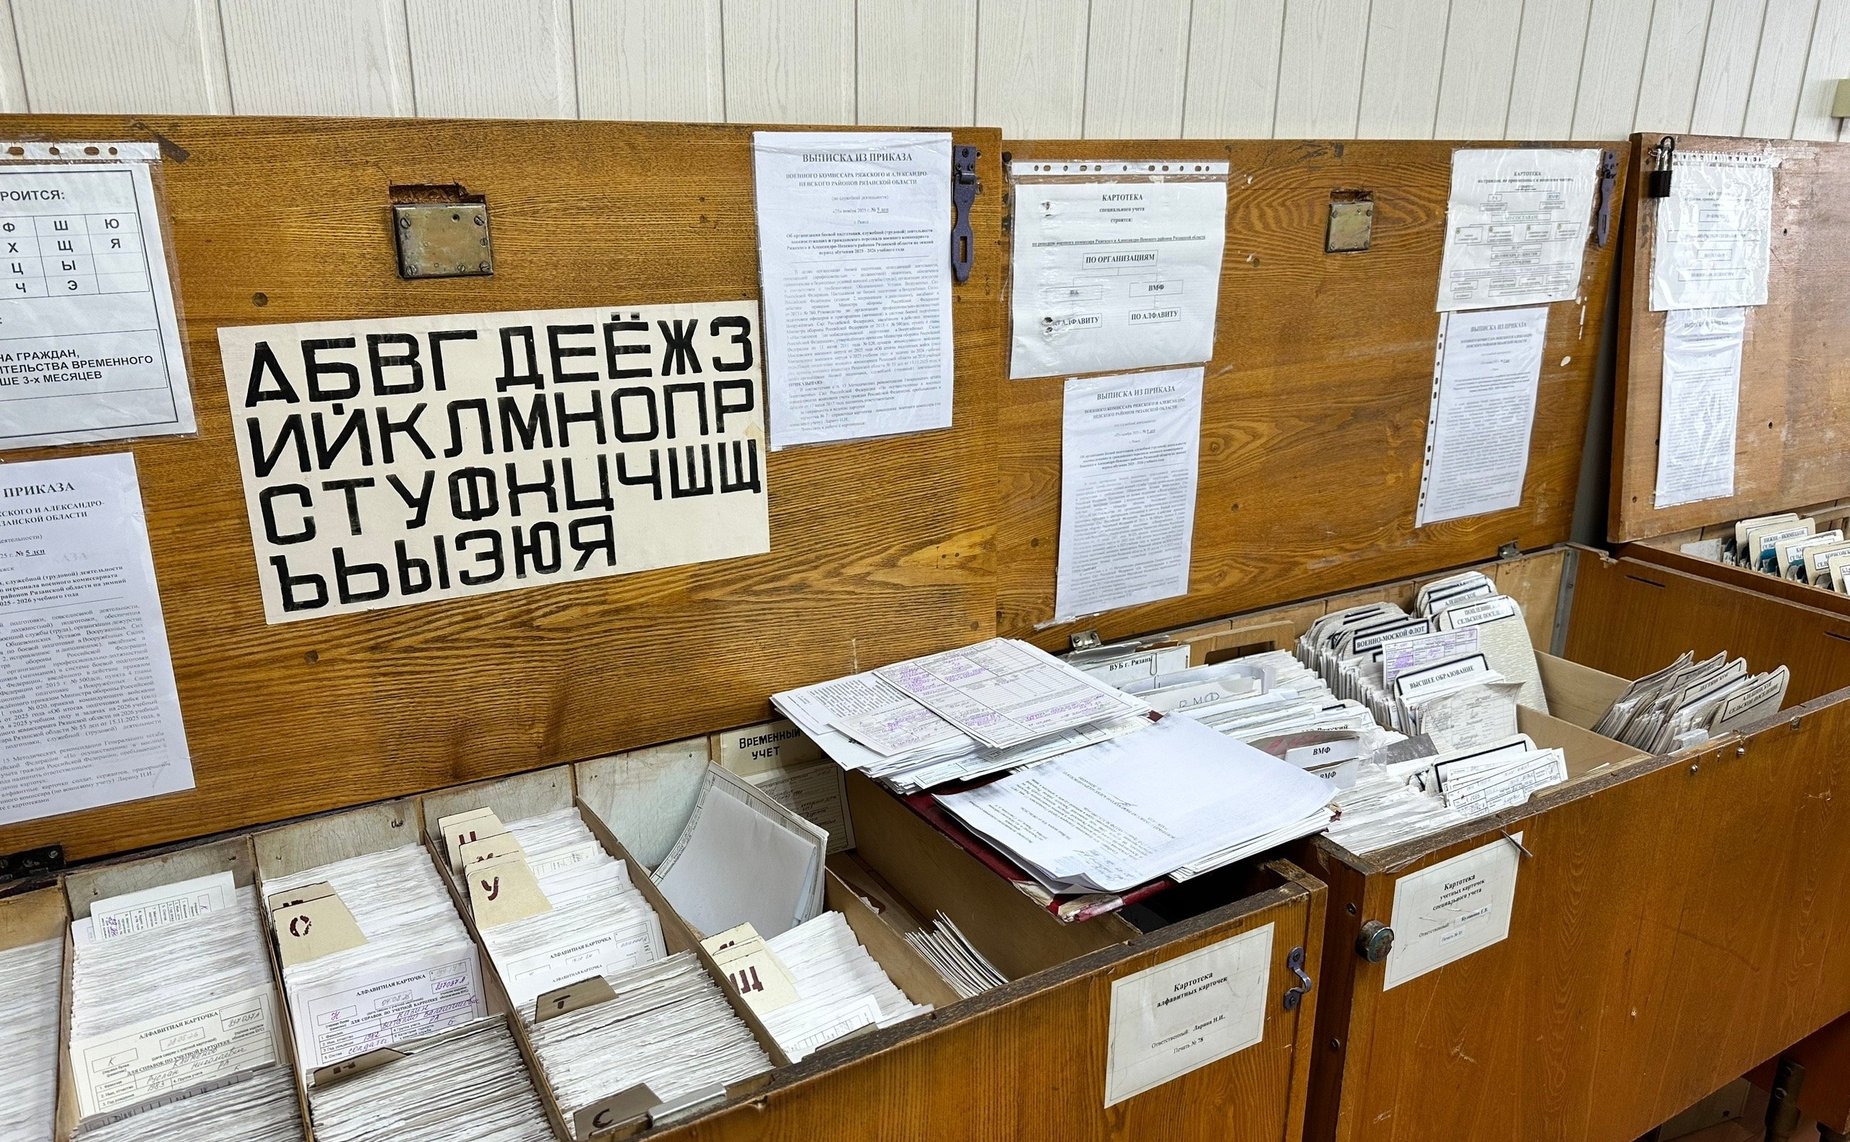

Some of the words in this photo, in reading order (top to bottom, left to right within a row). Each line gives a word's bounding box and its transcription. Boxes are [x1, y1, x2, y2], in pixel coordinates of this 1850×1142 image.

[802, 153, 855, 163] ВЫПИСКА
[856, 153, 867, 162] ИЗ
[869, 152, 912, 162] ПРИКАЗА
[1102, 193, 1143, 202] КАРТОТЕКА
[2, 222, 15, 233] Ф
[54, 220, 69, 231] Ш
[105, 219, 120, 229] Ю
[8, 243, 19, 253] Х
[57, 241, 73, 252] Щ
[111, 239, 121, 249] Я
[1086, 256, 1096, 264] ПО
[1098, 253, 1155, 263] ОРГАНИЗАЦИЯМ
[12, 263, 24, 275] Ц
[62, 261, 76, 271] Ы
[15, 283, 26, 293] Ч
[68, 280, 78, 291] Э
[1142, 310, 1179, 319] АЛФАВИТУ
[17, 349, 80, 361] ГРАЖДАН,
[72, 355, 153, 369] ВРЕМЕННОГО
[23, 376, 40, 384] 3-х
[43, 371, 102, 383] МЕСЯЦЕВ
[1097, 390, 1132, 400] ВЫПИСКА
[1144, 386, 1175, 395] ПРИКАЗА
[3, 482, 75, 497] ПРИКАЗА
[43, 500, 104, 512] АЛЕКСАНДРО-
[46, 512, 87, 521] ОБЛАСТИ
[1407, 626, 1426, 638] ФЛОТ
[1109, 661, 1124, 672] ВУБ
[1409, 675, 1436, 690] ВЫСШЕЕ
[1434, 665, 1474, 683] ОБРАЗОВАНИЕ
[752, 746, 780, 760] УЧЕТ
[1313, 747, 1331, 755] ВМФ
[1444, 874, 1475, 890] Картотека
[480, 876, 500, 901] У
[1440, 889, 1461, 901] учетных
[1462, 880, 1484, 891] карточек
[1433, 894, 1467, 911] специального
[1468, 888, 1482, 898] учета
[585, 936, 612, 948] КАРТОЧКА
[356, 980, 396, 996] АЛФАВИТНАЯ
[396, 974, 426, 987] КАРТОЧКА
[1174, 972, 1213, 992] Картотека
[1157, 989, 1197, 1008] алфавитных
[1199, 977, 1227, 991] карточек
[138, 1021, 184, 1040] АЛФАВИТНАЯ
[184, 1011, 219, 1026] КАРТОЧКА
[1151, 1029, 1188, 1048] Ответственный
[1174, 1044, 1190, 1053] Печать
[592, 1108, 613, 1129] С
